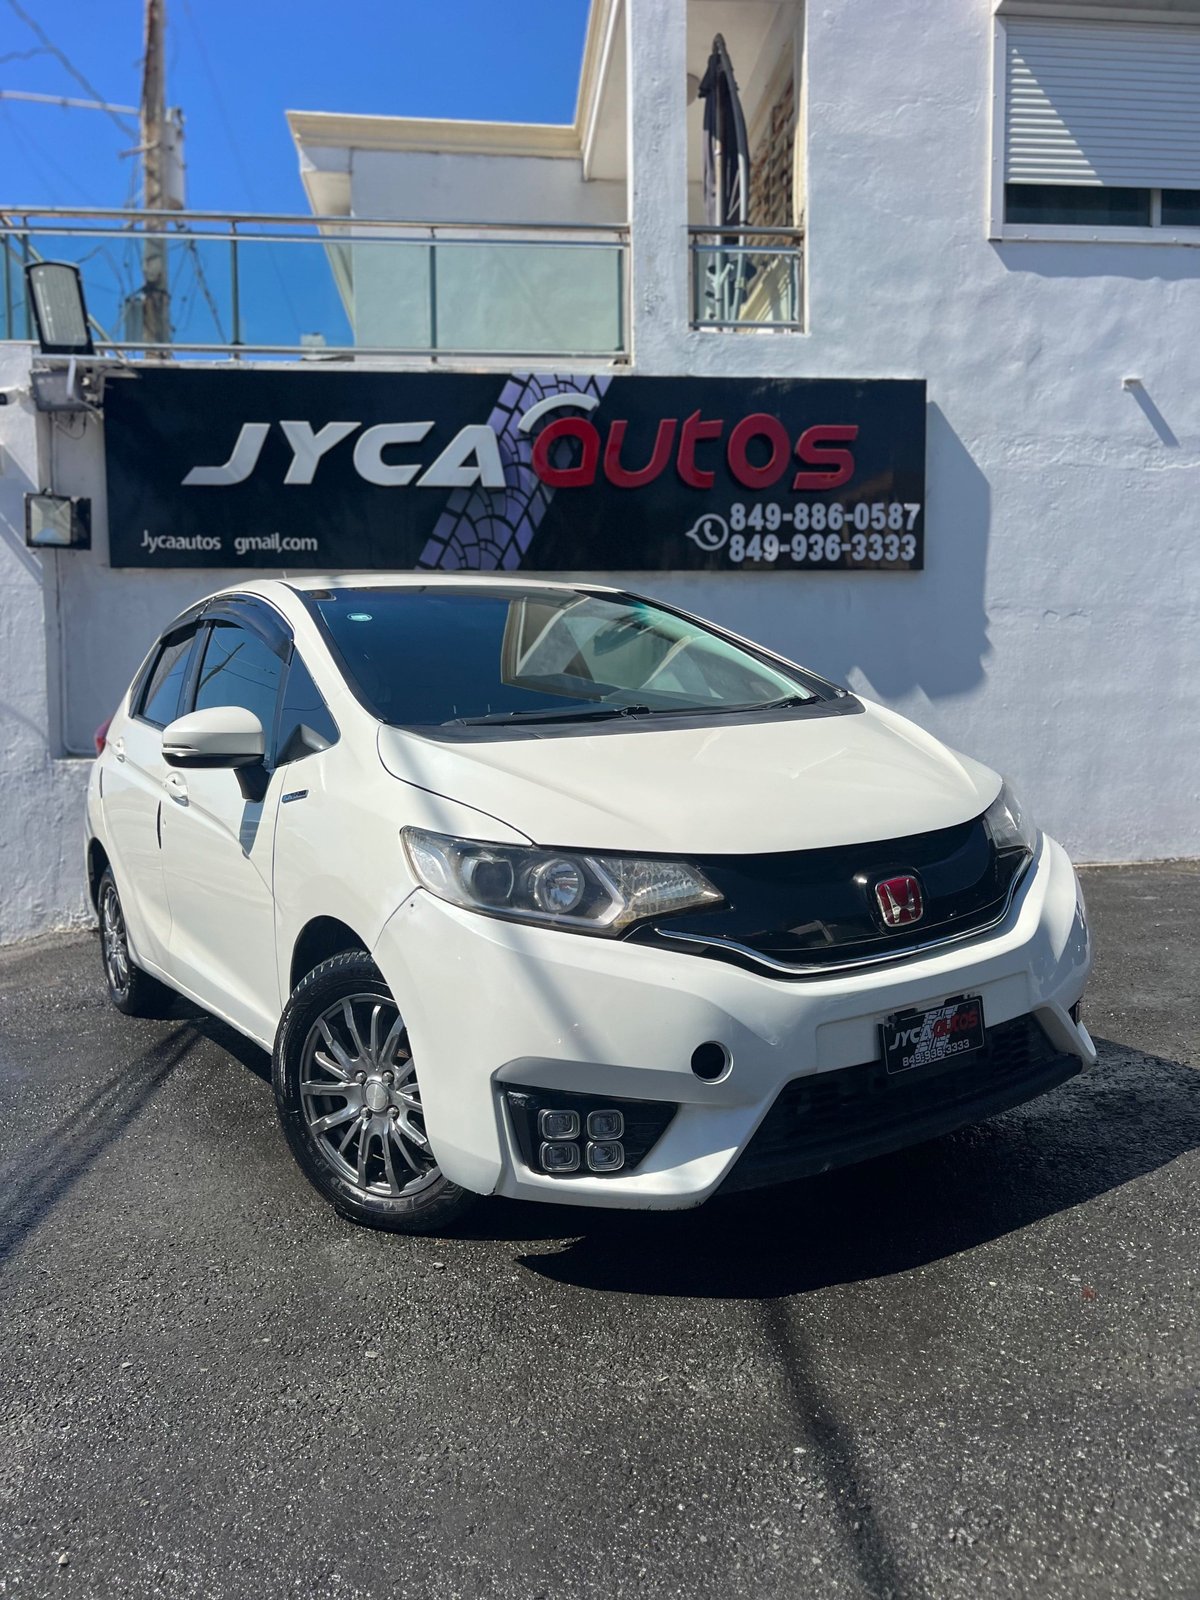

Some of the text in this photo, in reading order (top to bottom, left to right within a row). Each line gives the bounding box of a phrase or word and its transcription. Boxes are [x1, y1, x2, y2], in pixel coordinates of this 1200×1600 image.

[181, 420, 507, 488] JYCA
[729, 503, 921, 531] 849-886-0587
[140, 530, 222, 554] Jycaautos
[729, 534, 917, 562] 849-936-3333
[888, 1025, 932, 1051] JYCA
